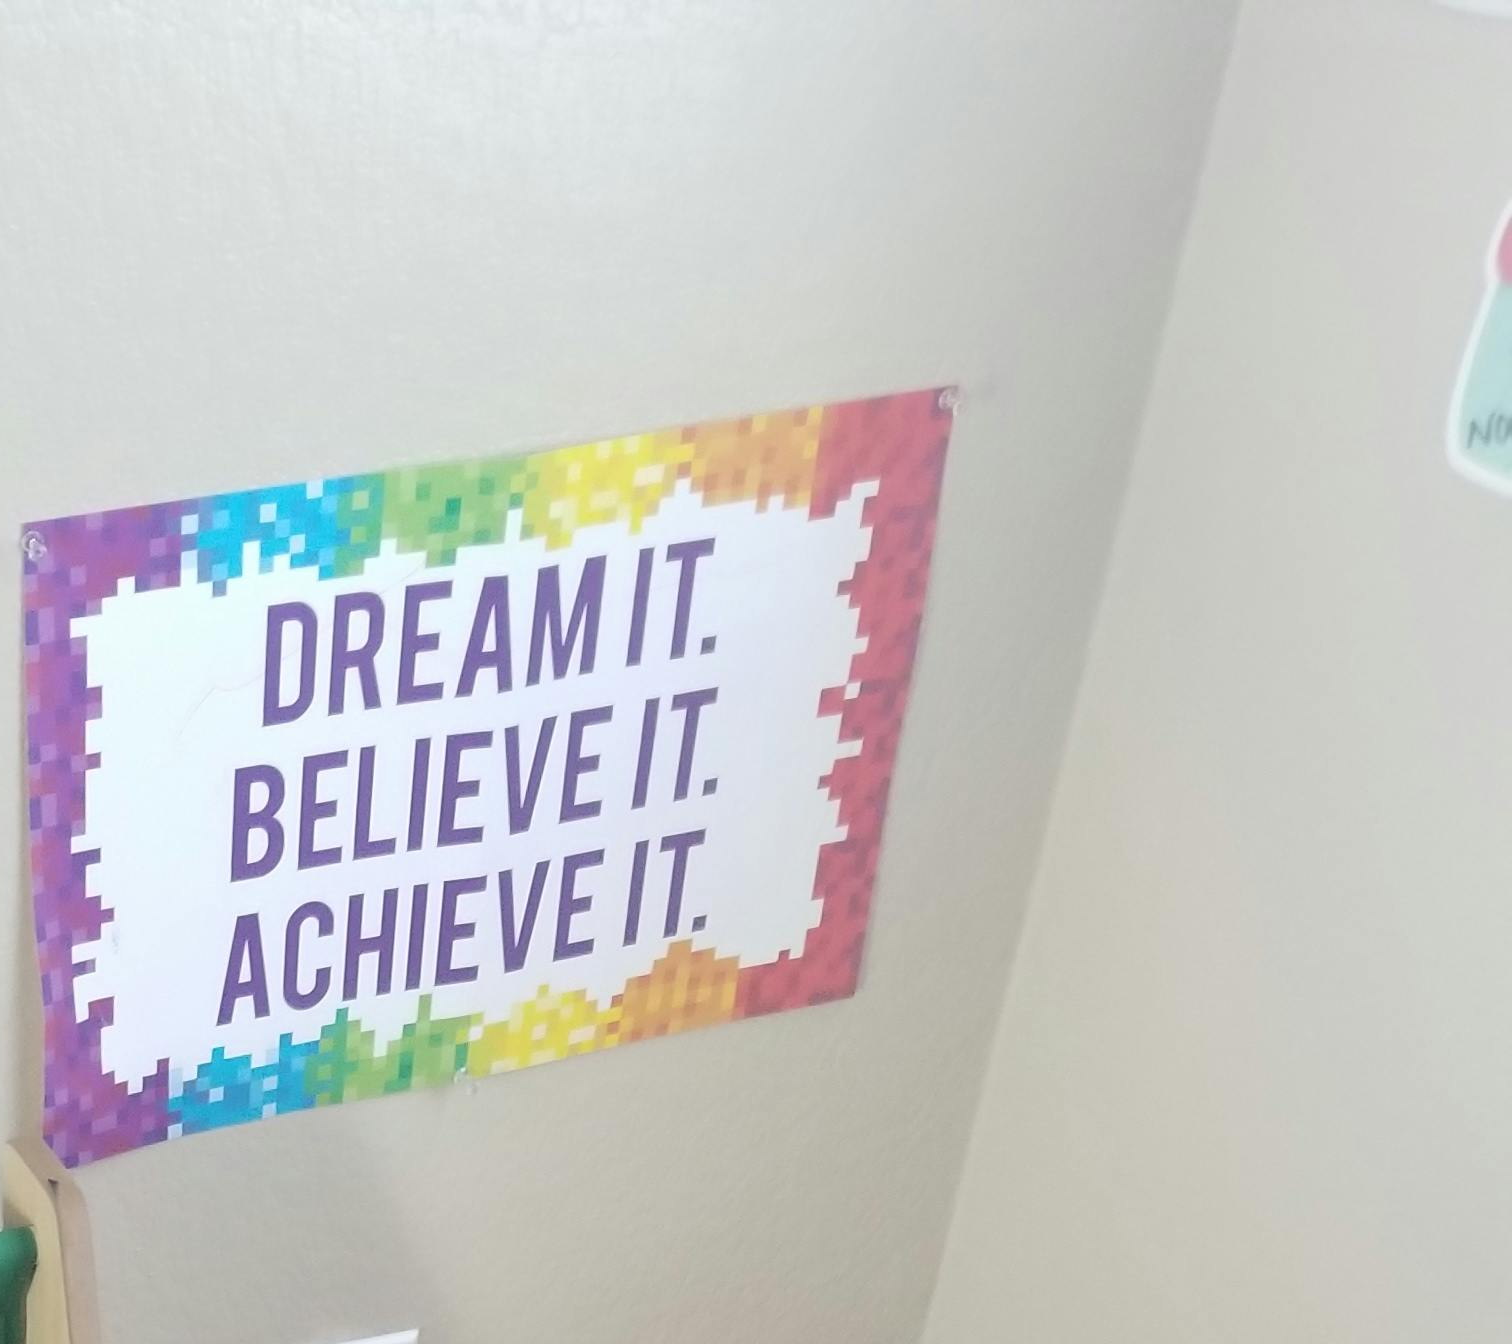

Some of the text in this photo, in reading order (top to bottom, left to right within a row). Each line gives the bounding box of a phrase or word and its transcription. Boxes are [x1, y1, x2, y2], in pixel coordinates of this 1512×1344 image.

[262, 537, 717, 727] DREAM IT.
[230, 687, 719, 883] BELIEVE IT.
[216, 828, 707, 1026] ACHIEVE IT.
